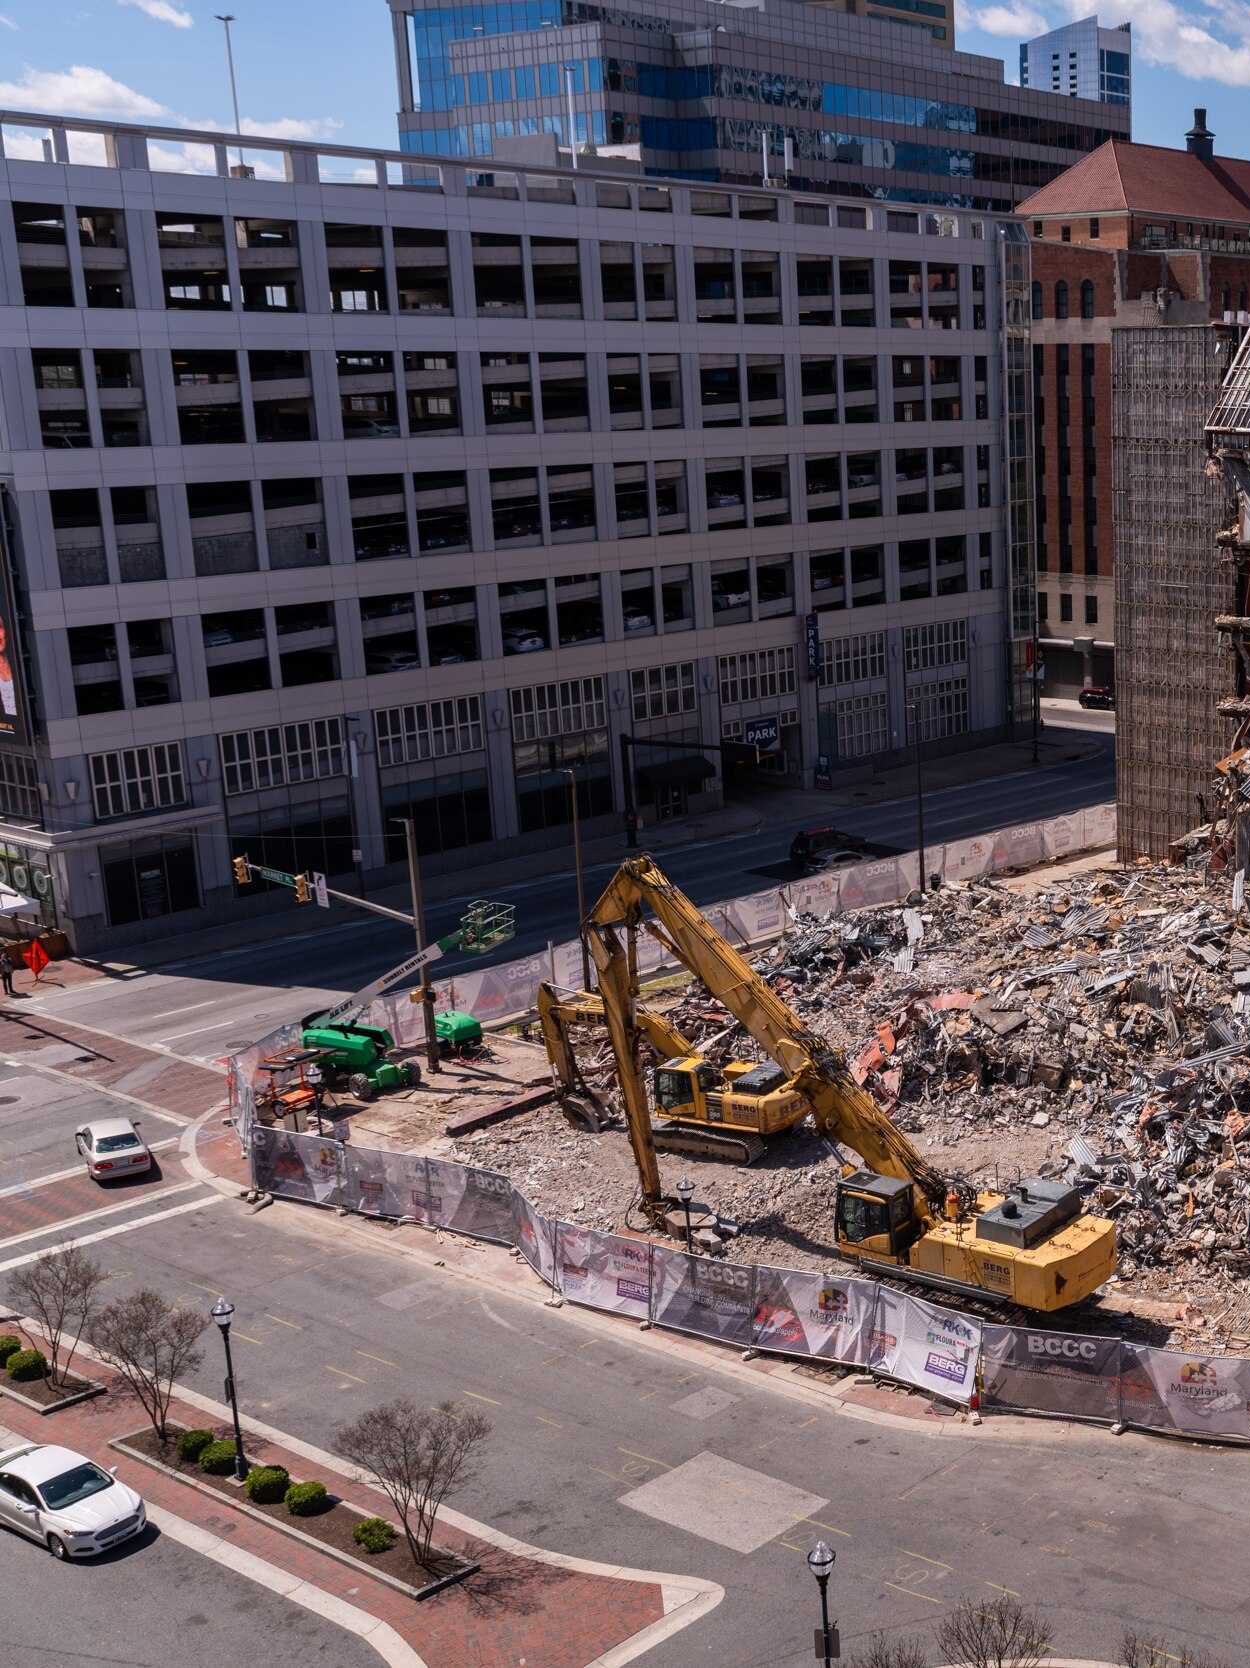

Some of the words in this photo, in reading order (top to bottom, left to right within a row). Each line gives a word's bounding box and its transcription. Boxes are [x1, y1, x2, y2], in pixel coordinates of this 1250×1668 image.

[808, 629, 816, 667] PARK
[747, 726, 777, 743] PARK
[262, 869, 283, 882] MARKET
[382, 967, 406, 985] SUNBELT
[404, 953, 428, 972] RENTALS
[340, 1000, 353, 1012] LIFT
[575, 1011, 607, 1026] BER
[731, 1103, 756, 1113] BERG
[696, 1262, 749, 1287] BCCC
[983, 1262, 1010, 1275] BERG
[809, 1309, 855, 1327] Maryland
[936, 1334, 956, 1347] FLOURA
[1027, 1335, 1097, 1359] BCCC
[929, 1354, 966, 1376] BERG
[1170, 1382, 1229, 1398] Maryland
